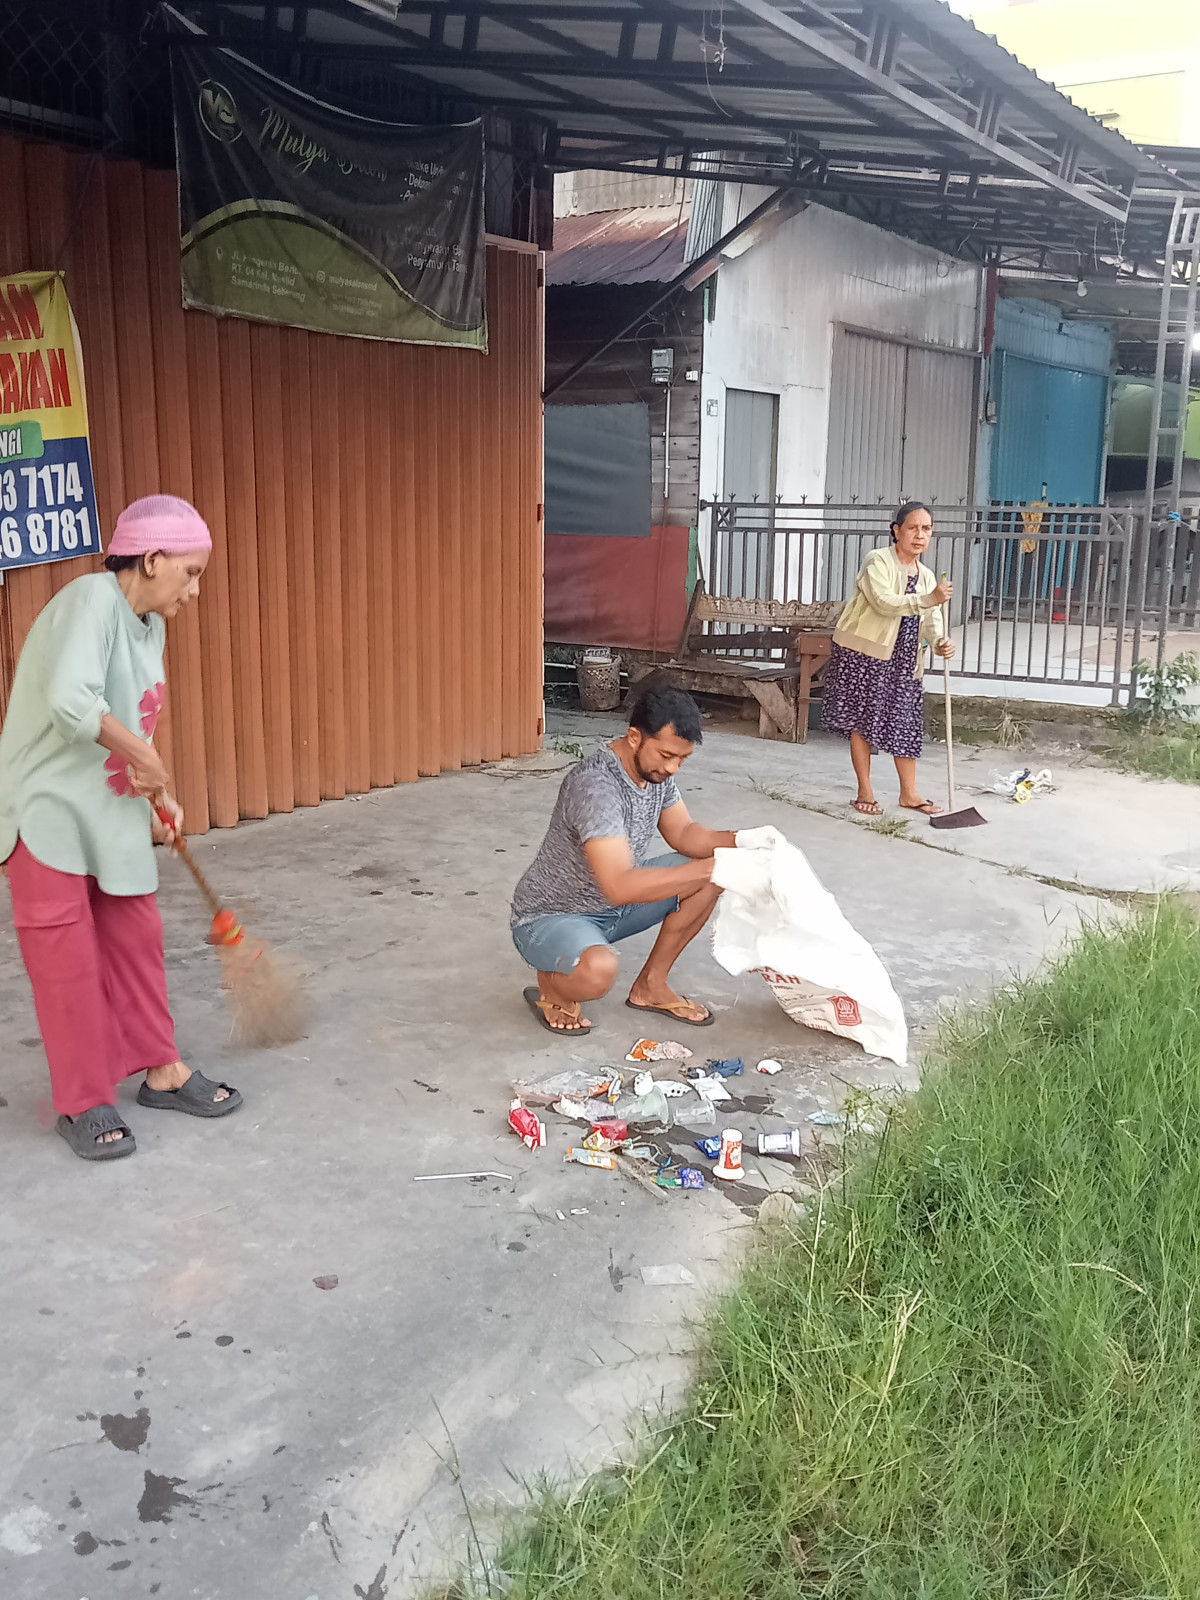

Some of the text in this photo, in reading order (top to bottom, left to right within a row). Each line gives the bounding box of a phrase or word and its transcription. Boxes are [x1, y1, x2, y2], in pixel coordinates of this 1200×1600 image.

[257, 106, 330, 178] Mulya
[0, 462, 84, 512] 3 7174
[0, 507, 93, 559] 6 8781
